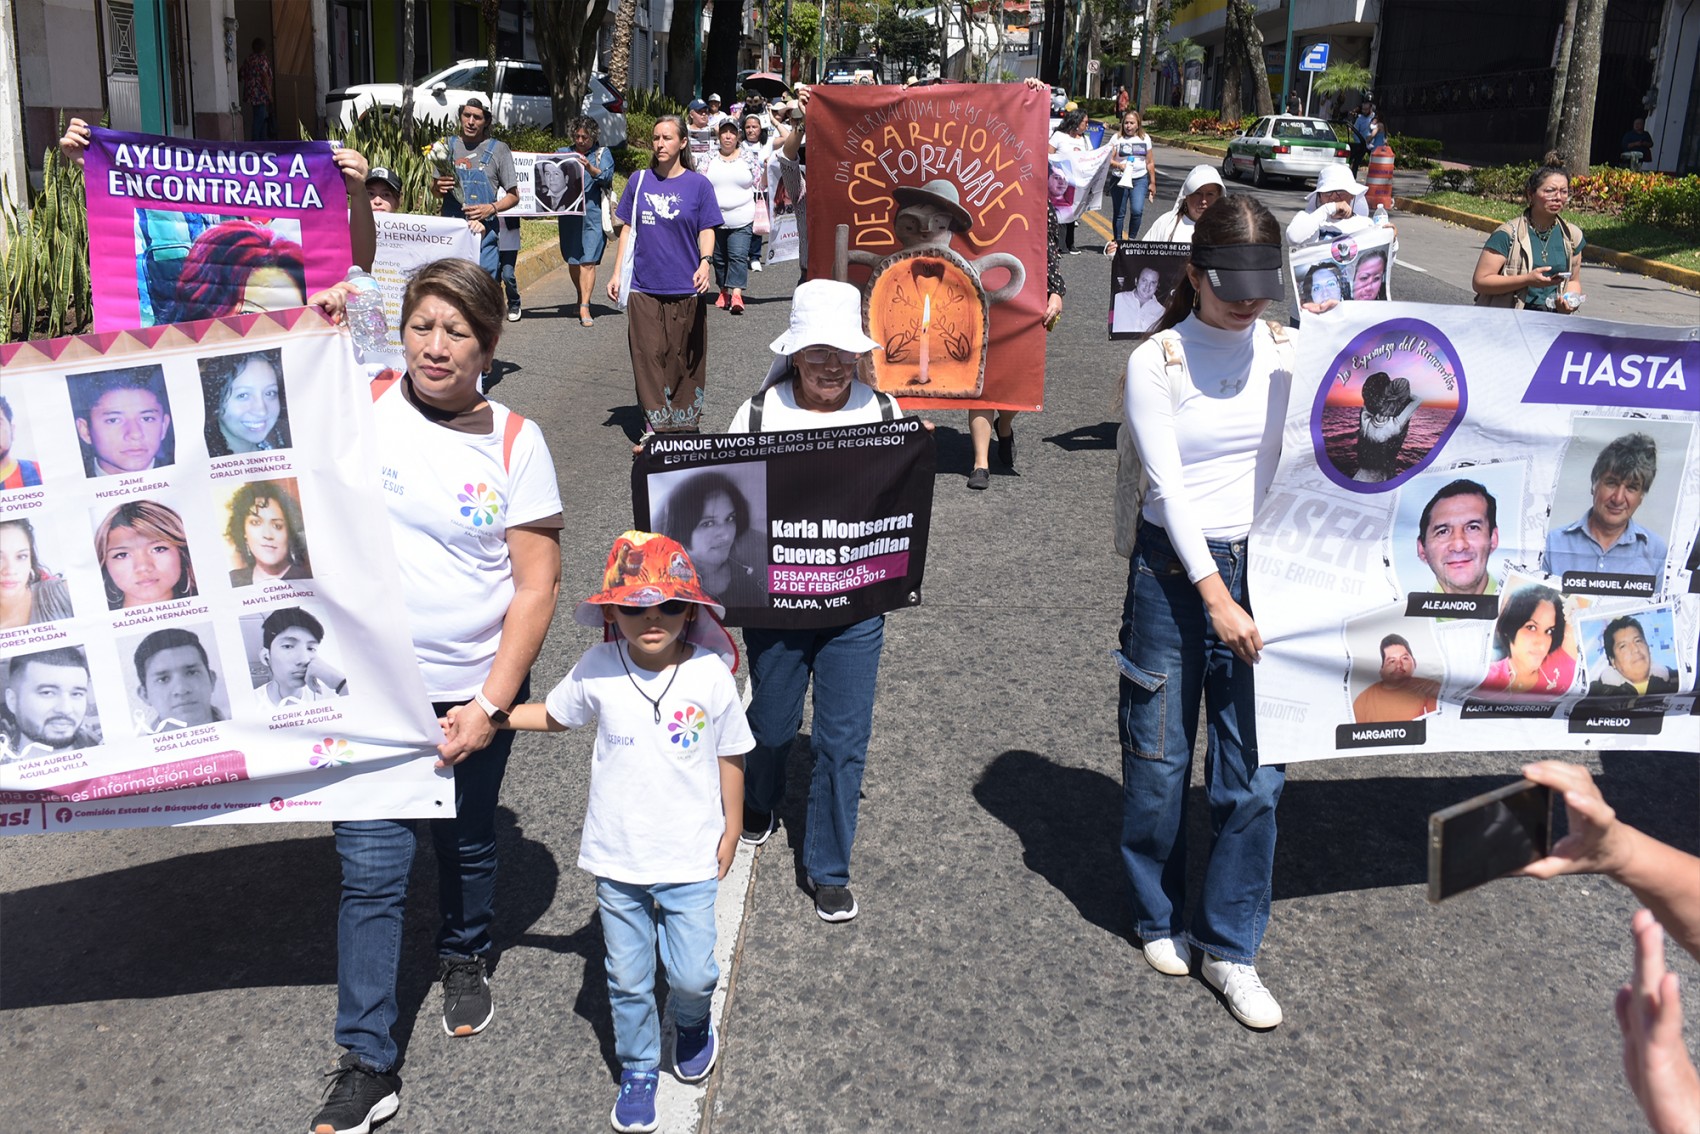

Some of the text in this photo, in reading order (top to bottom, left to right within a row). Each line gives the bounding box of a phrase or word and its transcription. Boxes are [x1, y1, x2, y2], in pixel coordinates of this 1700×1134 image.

[1304, 45, 1324, 68] E
[842, 100, 941, 155] INTERNACIONAL
[949, 100, 959, 120] DE
[1019, 163, 1034, 181] DE
[115, 142, 308, 178] AYÚDANOS A
[848, 121, 1030, 246] DESAPARICIONES
[877, 144, 1003, 206] FORZADAS
[108, 170, 323, 209] ENCONTRARLA
[384, 221, 427, 232] CARLOS
[384, 231, 453, 245] HERNÁNDEZ
[1398, 335, 1418, 352] del
[1560, 351, 1686, 391] HASTA
[650, 421, 919, 455] ¡AUNQUE VIVOS SE LOS LLEVARON CÓMO
[664, 435, 905, 464] ESTÉN LOS QUEREMOS DE REGRESO!
[210, 460, 245, 470] SANDRA
[210, 463, 292, 479] GIRALDI HERNÁNDEZ
[95, 482, 170, 499] HUESCA CABRERA
[119, 478, 144, 486] JAIME
[380, 478, 405, 496] ESUS
[1, 491, 45, 503] ALFONSO
[6, 501, 42, 511] OVIEDO
[772, 513, 914, 538] Karla Montserrat
[772, 544, 837, 564] Cuevas
[773, 564, 869, 581] DESAPARECIO EL
[773, 569, 886, 592] 24 DE FEBRERO 2012
[1285, 560, 1337, 591] ERROR
[1340, 576, 1366, 597] SIT
[1563, 577, 1654, 592] JOSÉ MIGUEL ÁNGEL
[242, 590, 315, 606] MAVIL HERNÁNDEZ
[773, 596, 851, 610] XALAPA, VER.
[1421, 600, 1477, 612] ALEJANDRO
[124, 600, 193, 617] KARLA NALLELY
[156, 605, 209, 620] HERNÁNDEZ
[271, 705, 335, 721] CEDRIK ABDIEL
[1465, 703, 1551, 713] KARLA MONSERRATH
[268, 713, 343, 731] RAMÍREZ AGUILAR
[1585, 717, 1631, 727] ALFREDO
[152, 726, 216, 745] IVÁN DE JESÚS
[1352, 729, 1407, 740] MARGARITO
[154, 736, 220, 753] SOSA LAGUNES
[18, 752, 83, 771] IVÁN AURELIO
[19, 760, 89, 780] AGUILAR VILLA
[92, 767, 189, 798] información
[192, 759, 217, 777] del
[74, 808, 116, 817] Comisión
[118, 805, 149, 816] Estatal
[151, 805, 162, 813] de
[164, 801, 213, 815] Búsqueda
[214, 803, 223, 811] de
